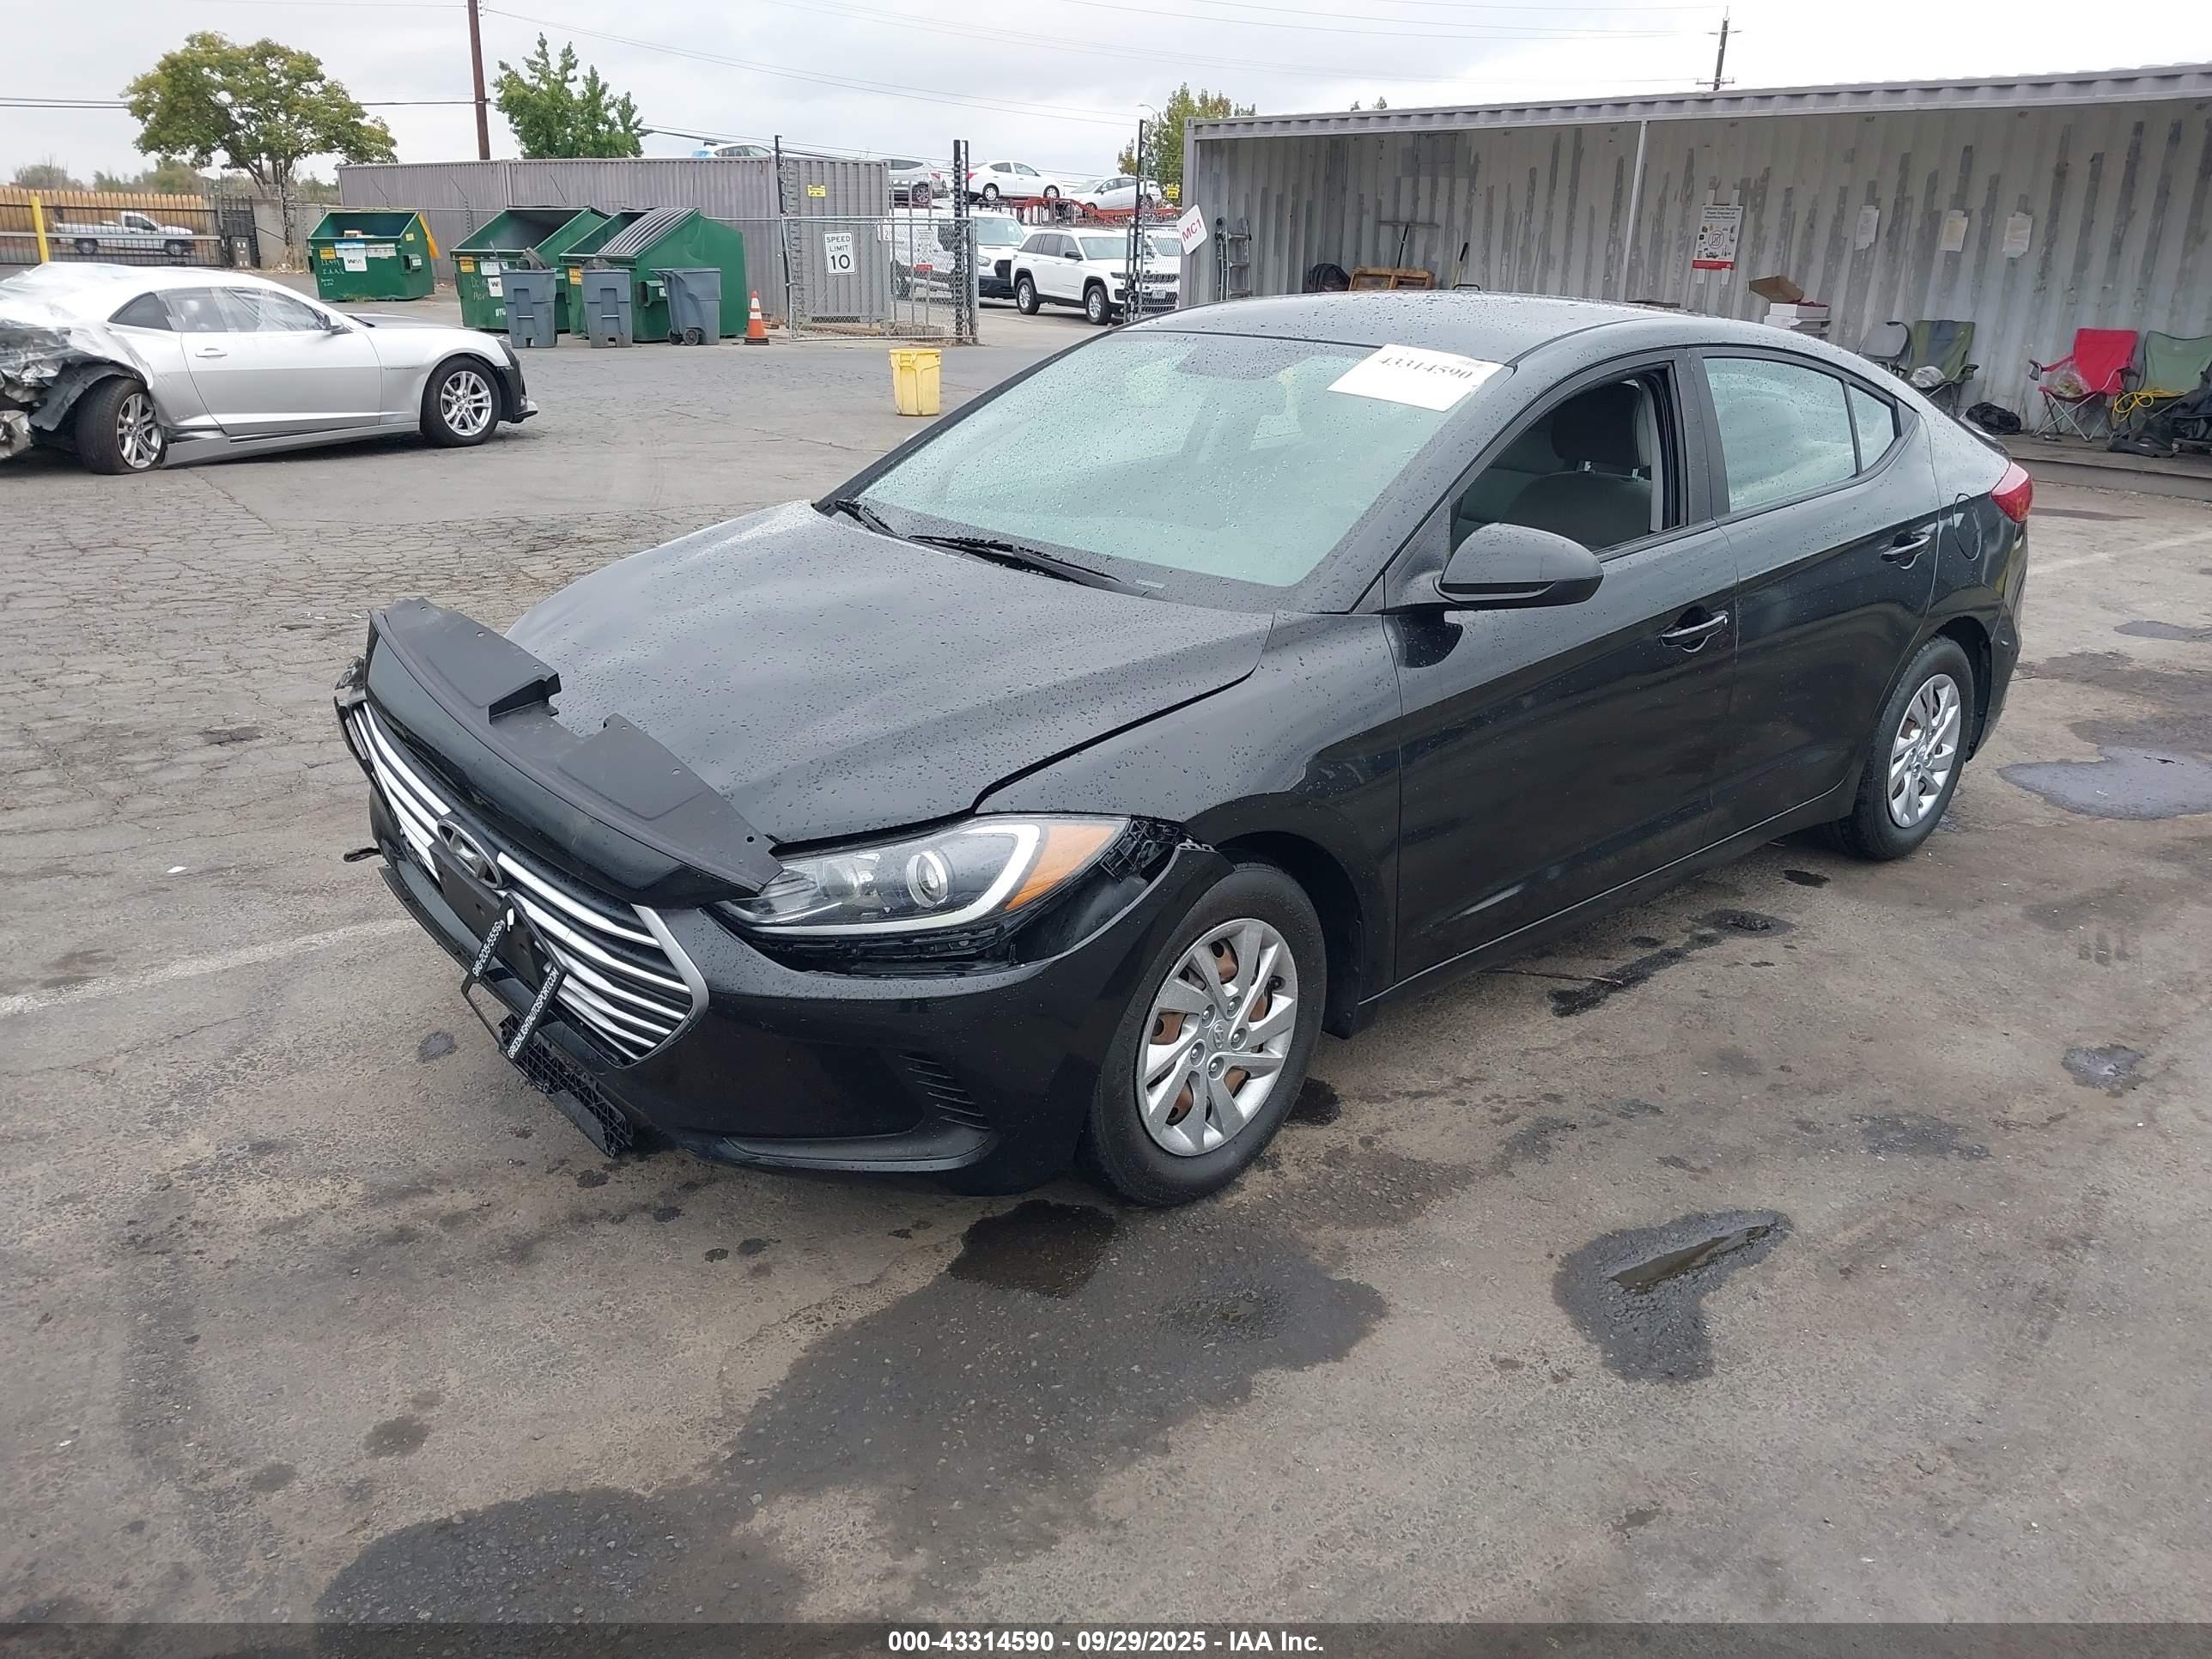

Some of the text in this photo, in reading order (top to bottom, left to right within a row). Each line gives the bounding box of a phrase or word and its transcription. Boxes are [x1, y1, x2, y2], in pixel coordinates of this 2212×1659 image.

[1182, 218, 1202, 242] MC1
[830, 253, 851, 270] 10
[1376, 356, 1474, 379] 43314590
